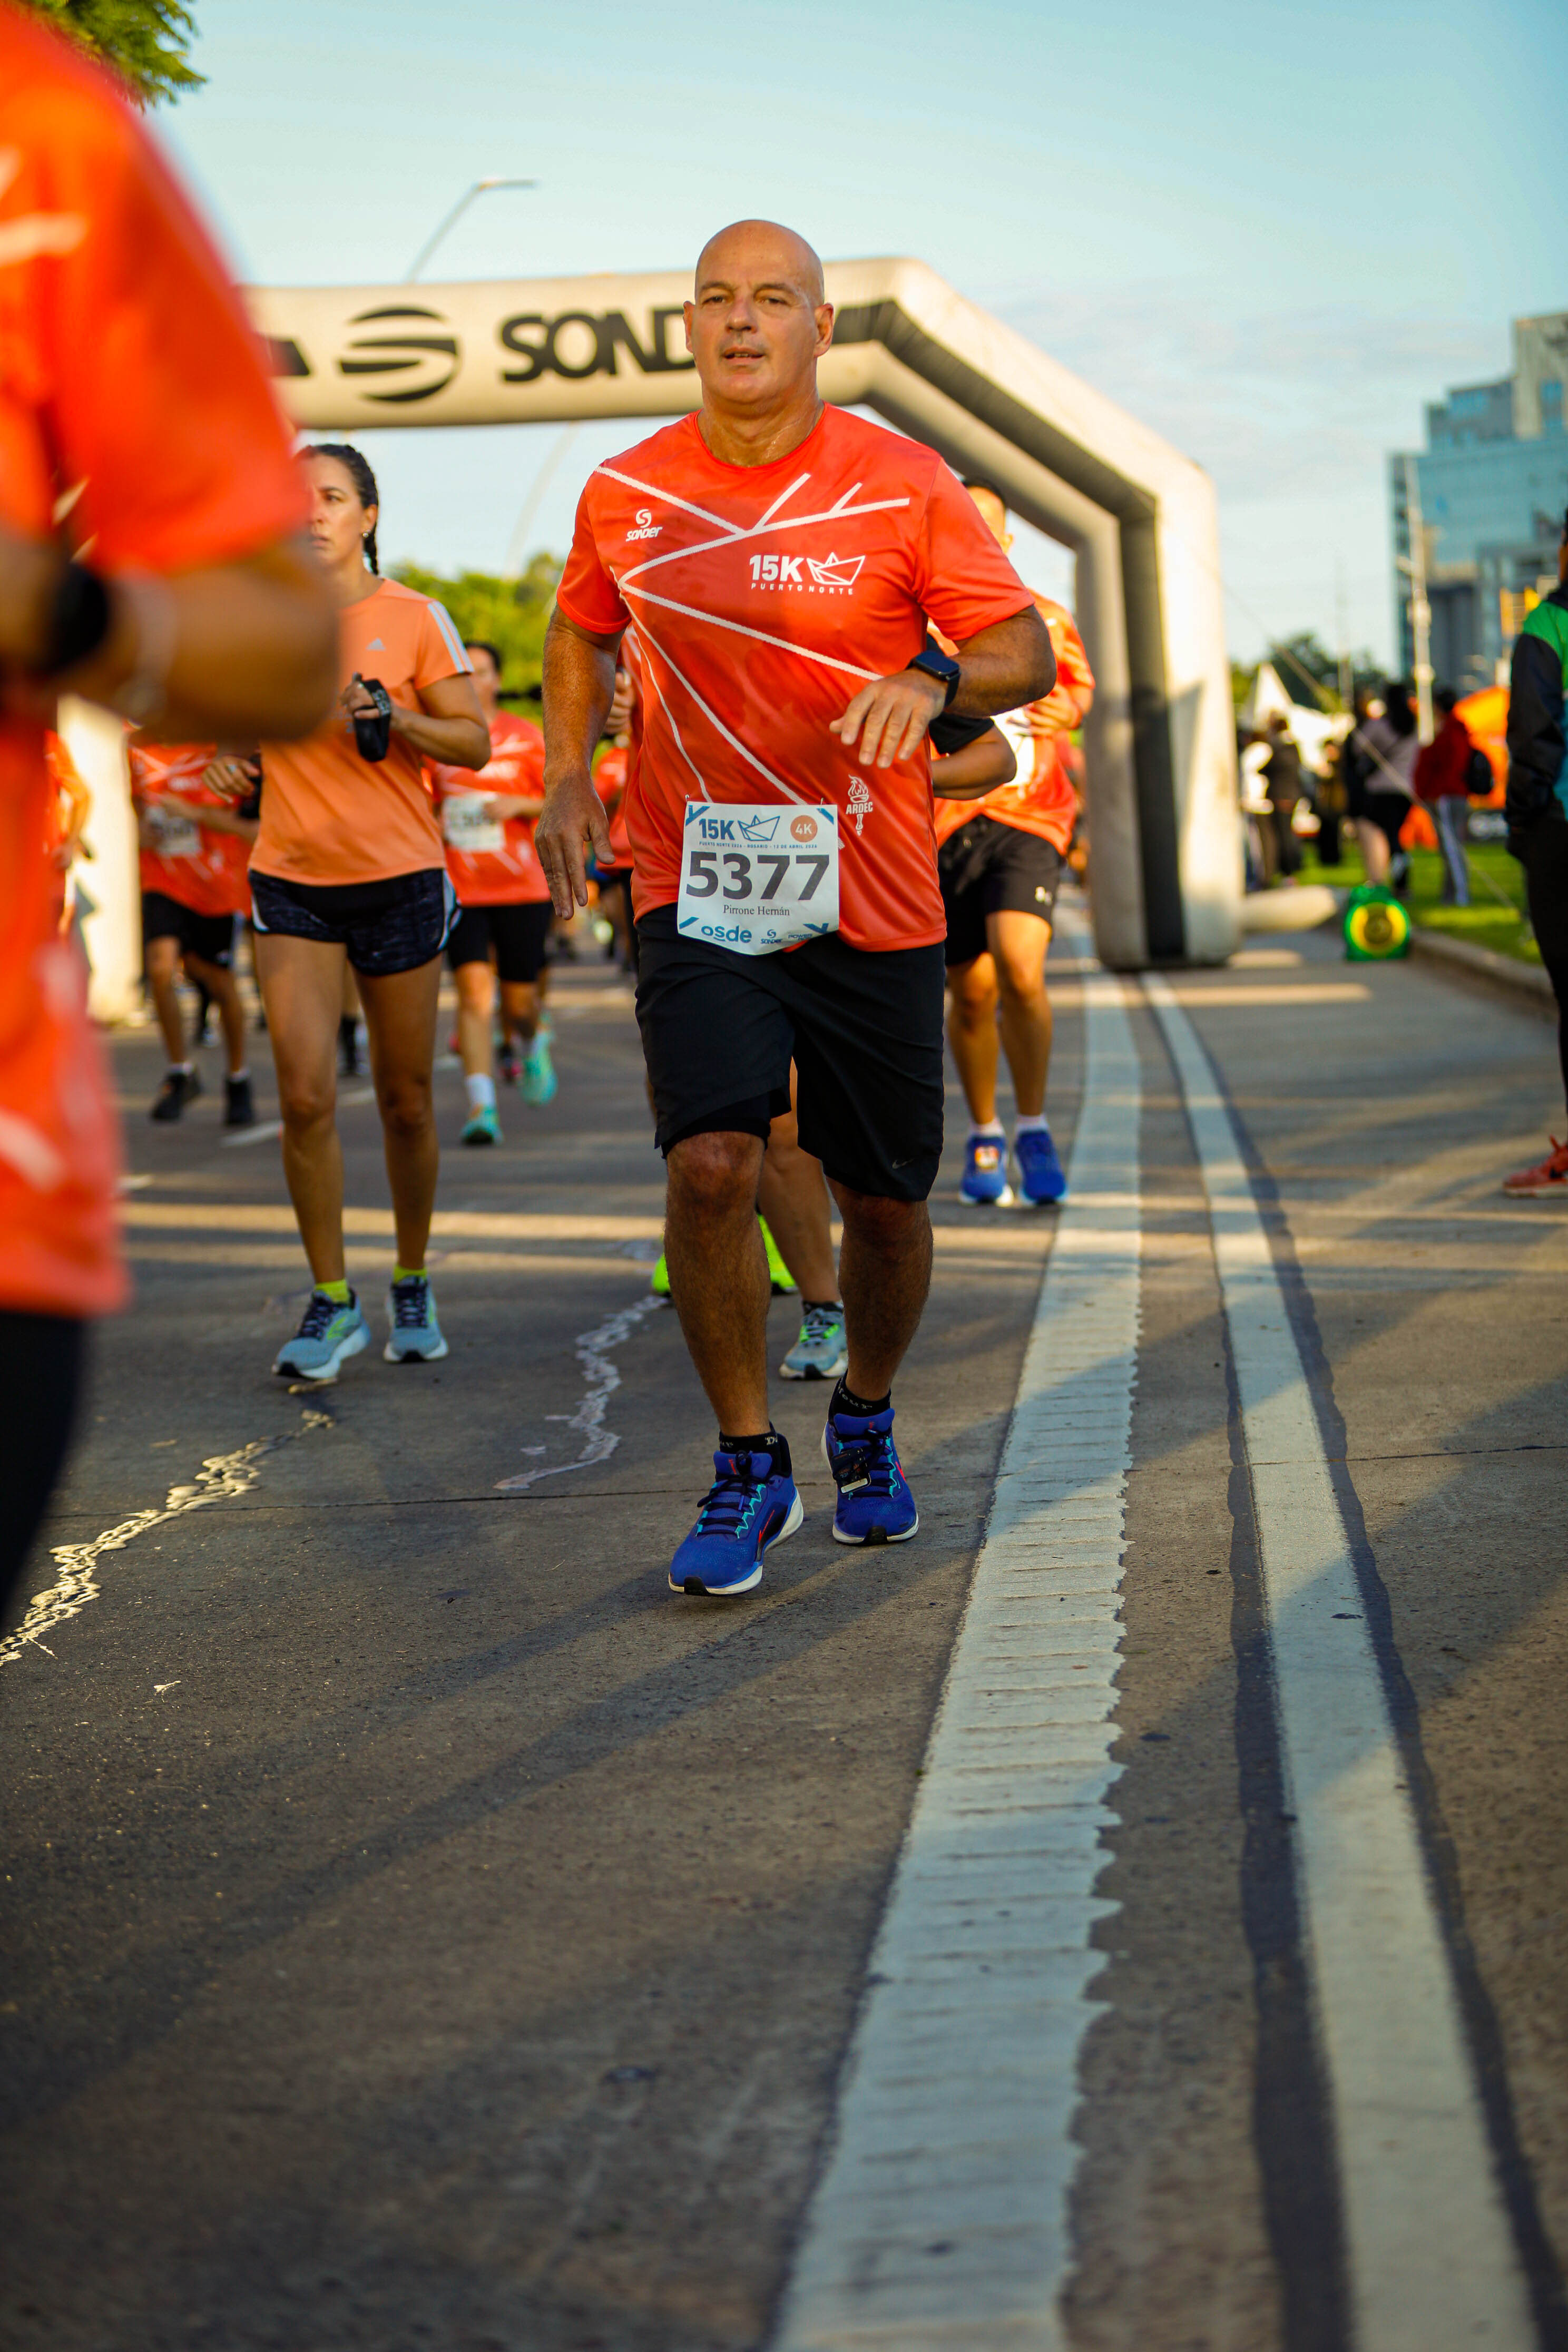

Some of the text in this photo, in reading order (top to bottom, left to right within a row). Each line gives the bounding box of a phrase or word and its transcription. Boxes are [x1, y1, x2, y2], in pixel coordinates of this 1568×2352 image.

[749, 554, 805, 582] 15K
[751, 583, 854, 595] PUERTO NORTE
[846, 801, 873, 815] ARDEC
[699, 818, 735, 840] 15K
[795, 823, 812, 834] 4K
[686, 850, 829, 900] 5377
[723, 904, 790, 916] Pirrone Hernán
[701, 925, 752, 943] osde
